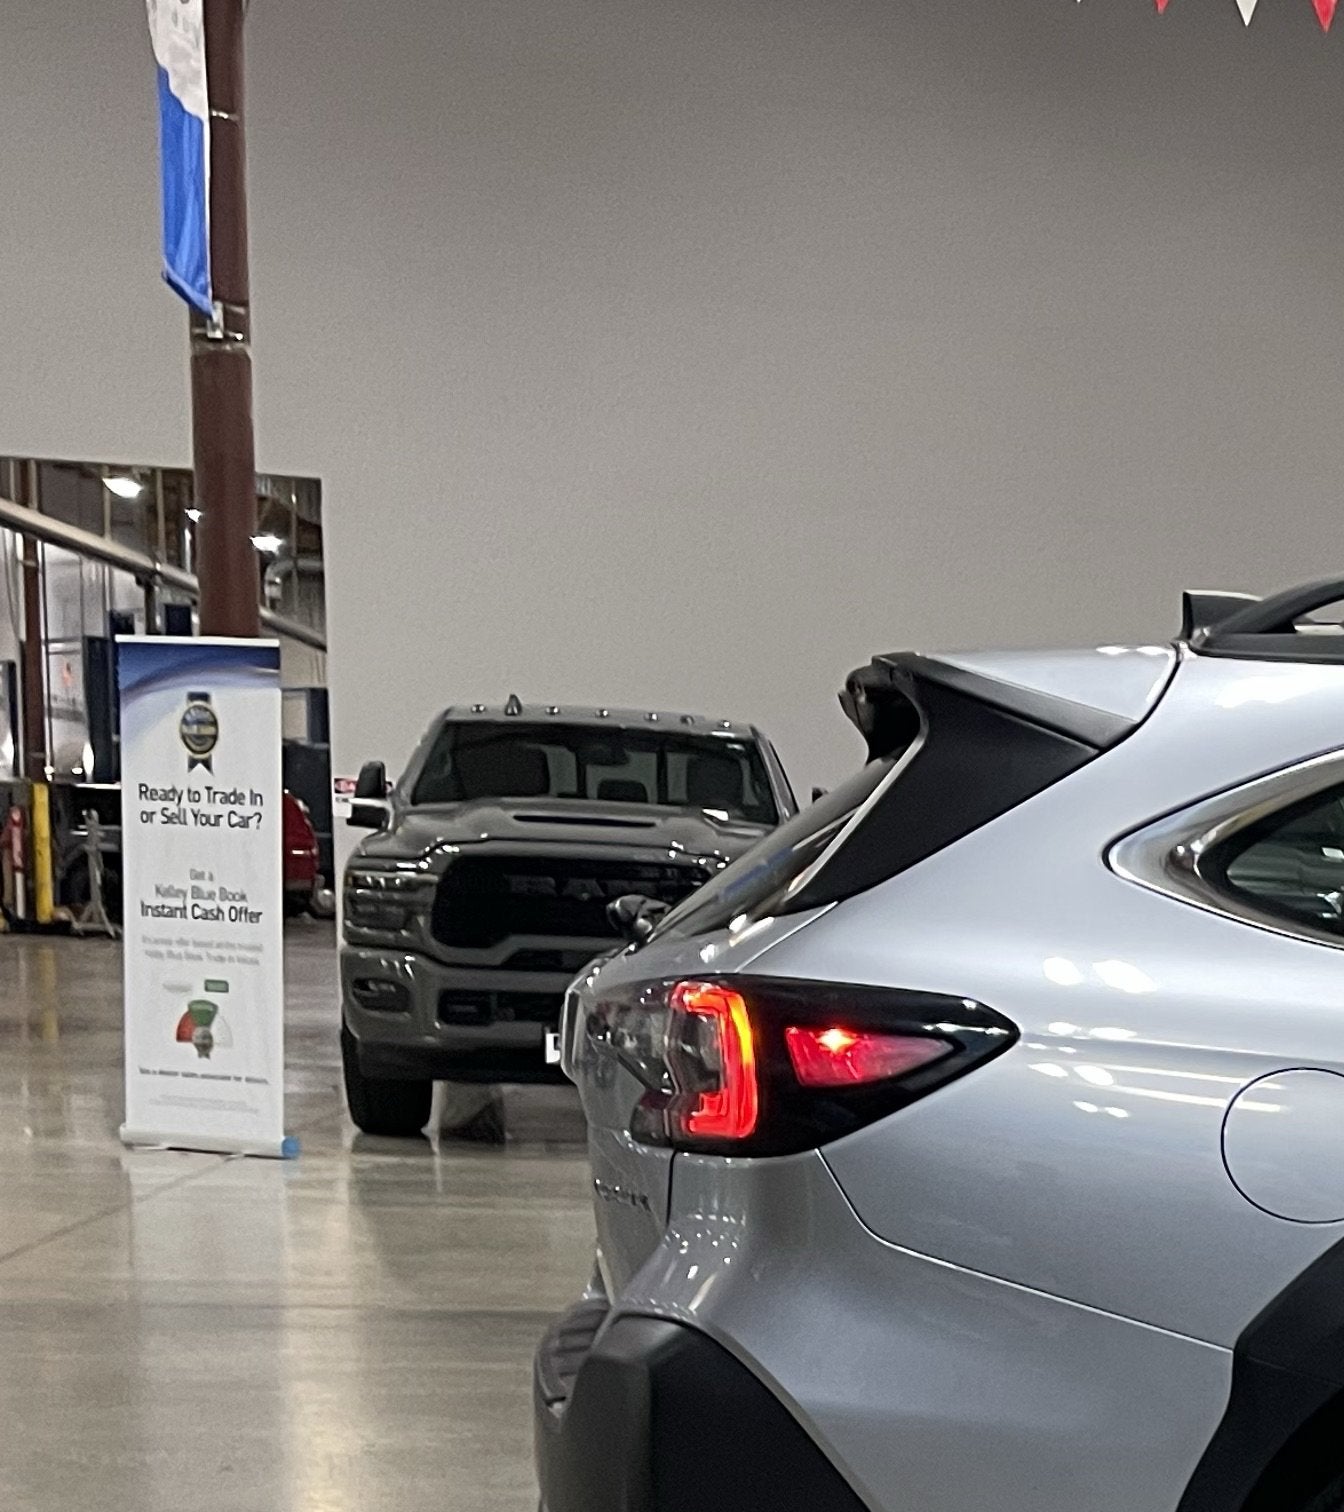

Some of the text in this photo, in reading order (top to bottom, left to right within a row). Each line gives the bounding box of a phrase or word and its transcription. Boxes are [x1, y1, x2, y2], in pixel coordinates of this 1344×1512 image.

[138, 783, 264, 807] Ready to Trade In
[140, 807, 263, 830] or Sell Your Car?
[140, 900, 263, 924] Instant Cash Offer
